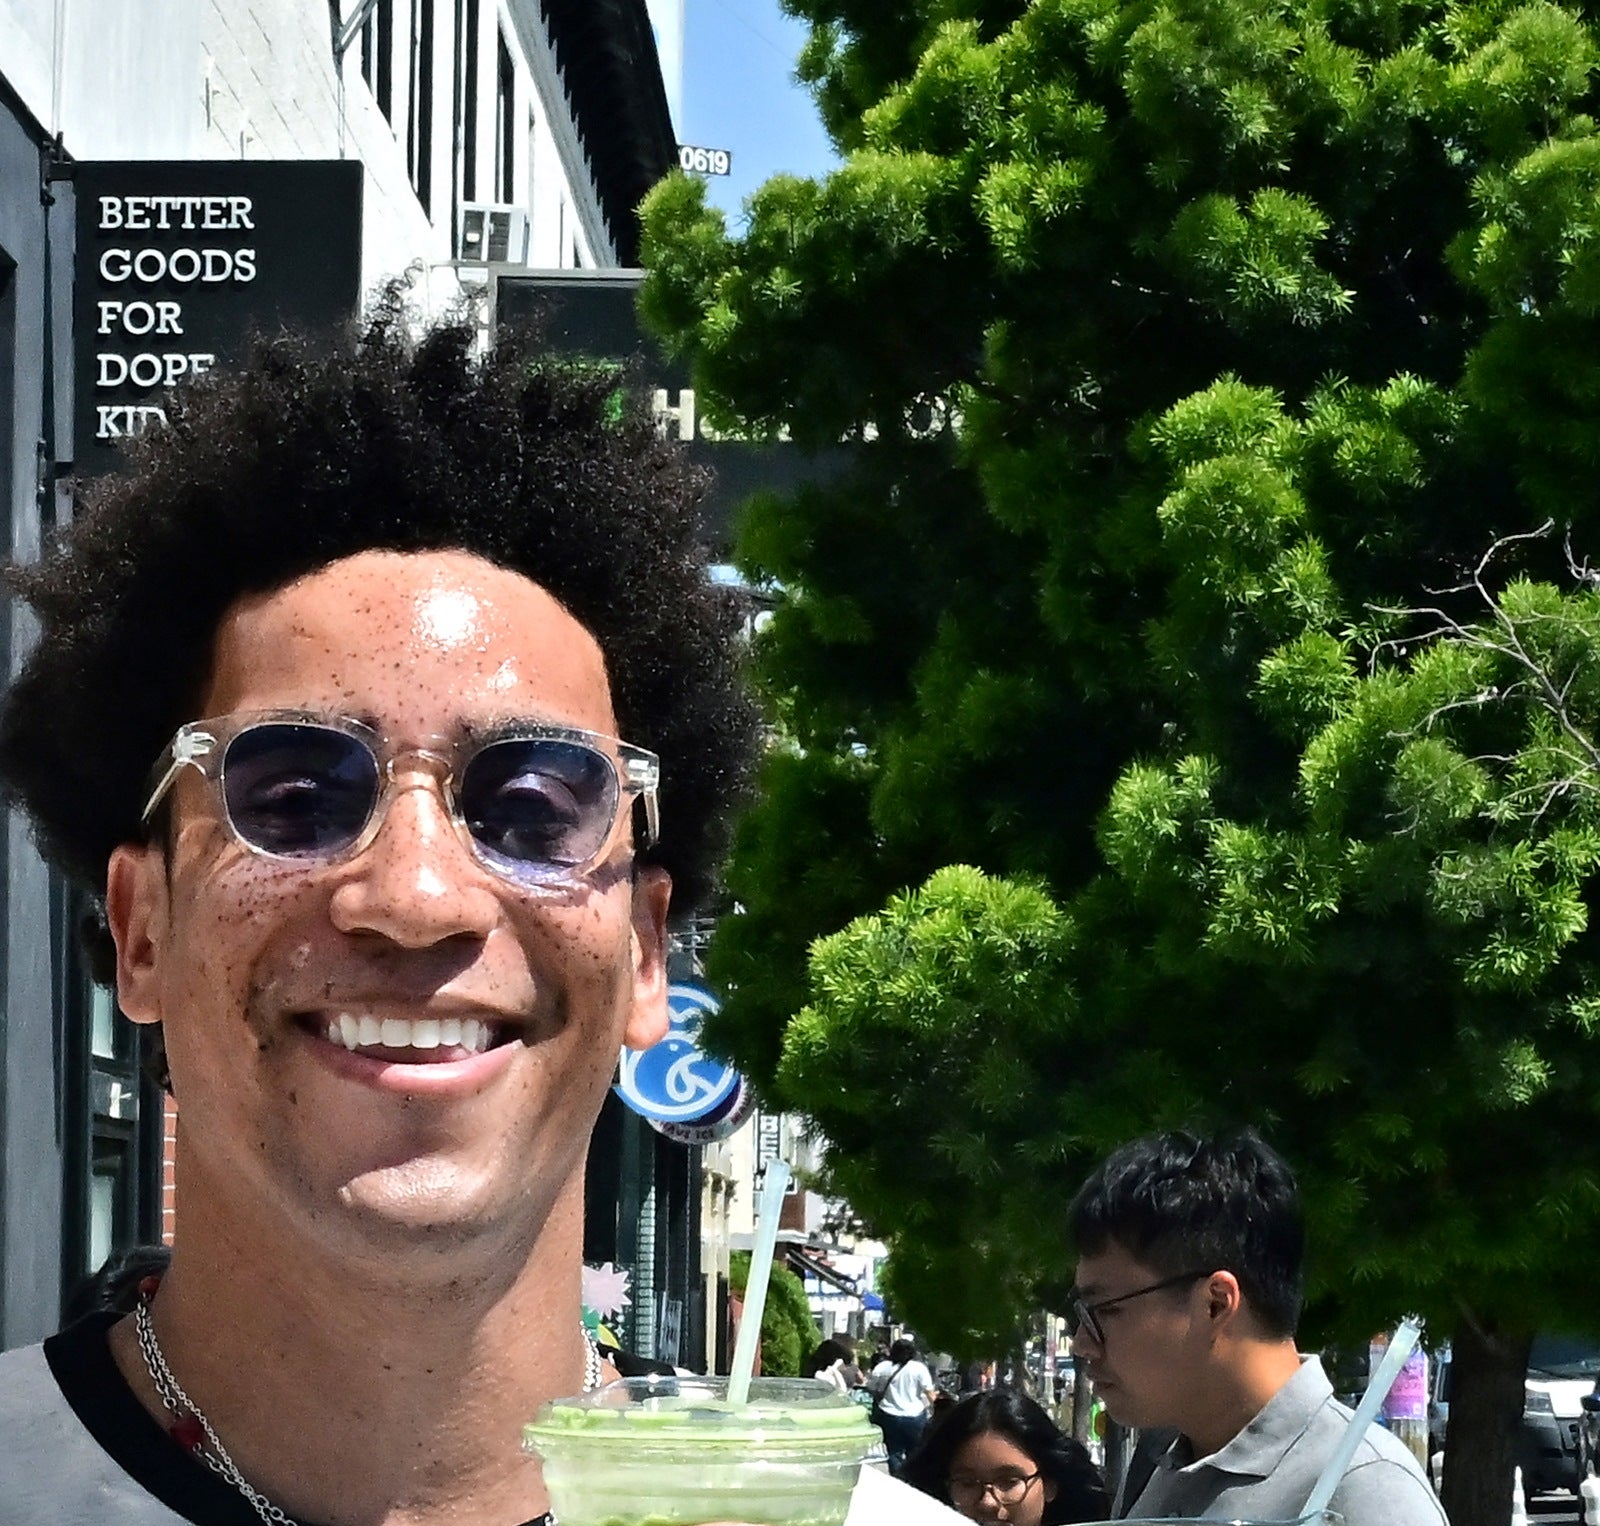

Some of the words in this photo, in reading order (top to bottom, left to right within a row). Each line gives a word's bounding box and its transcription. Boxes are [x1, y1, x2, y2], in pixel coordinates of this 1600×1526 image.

[680, 146, 729, 175] 0619
[99, 196, 255, 229] BETTER
[100, 248, 257, 282] GOODS
[97, 301, 184, 335] FOR
